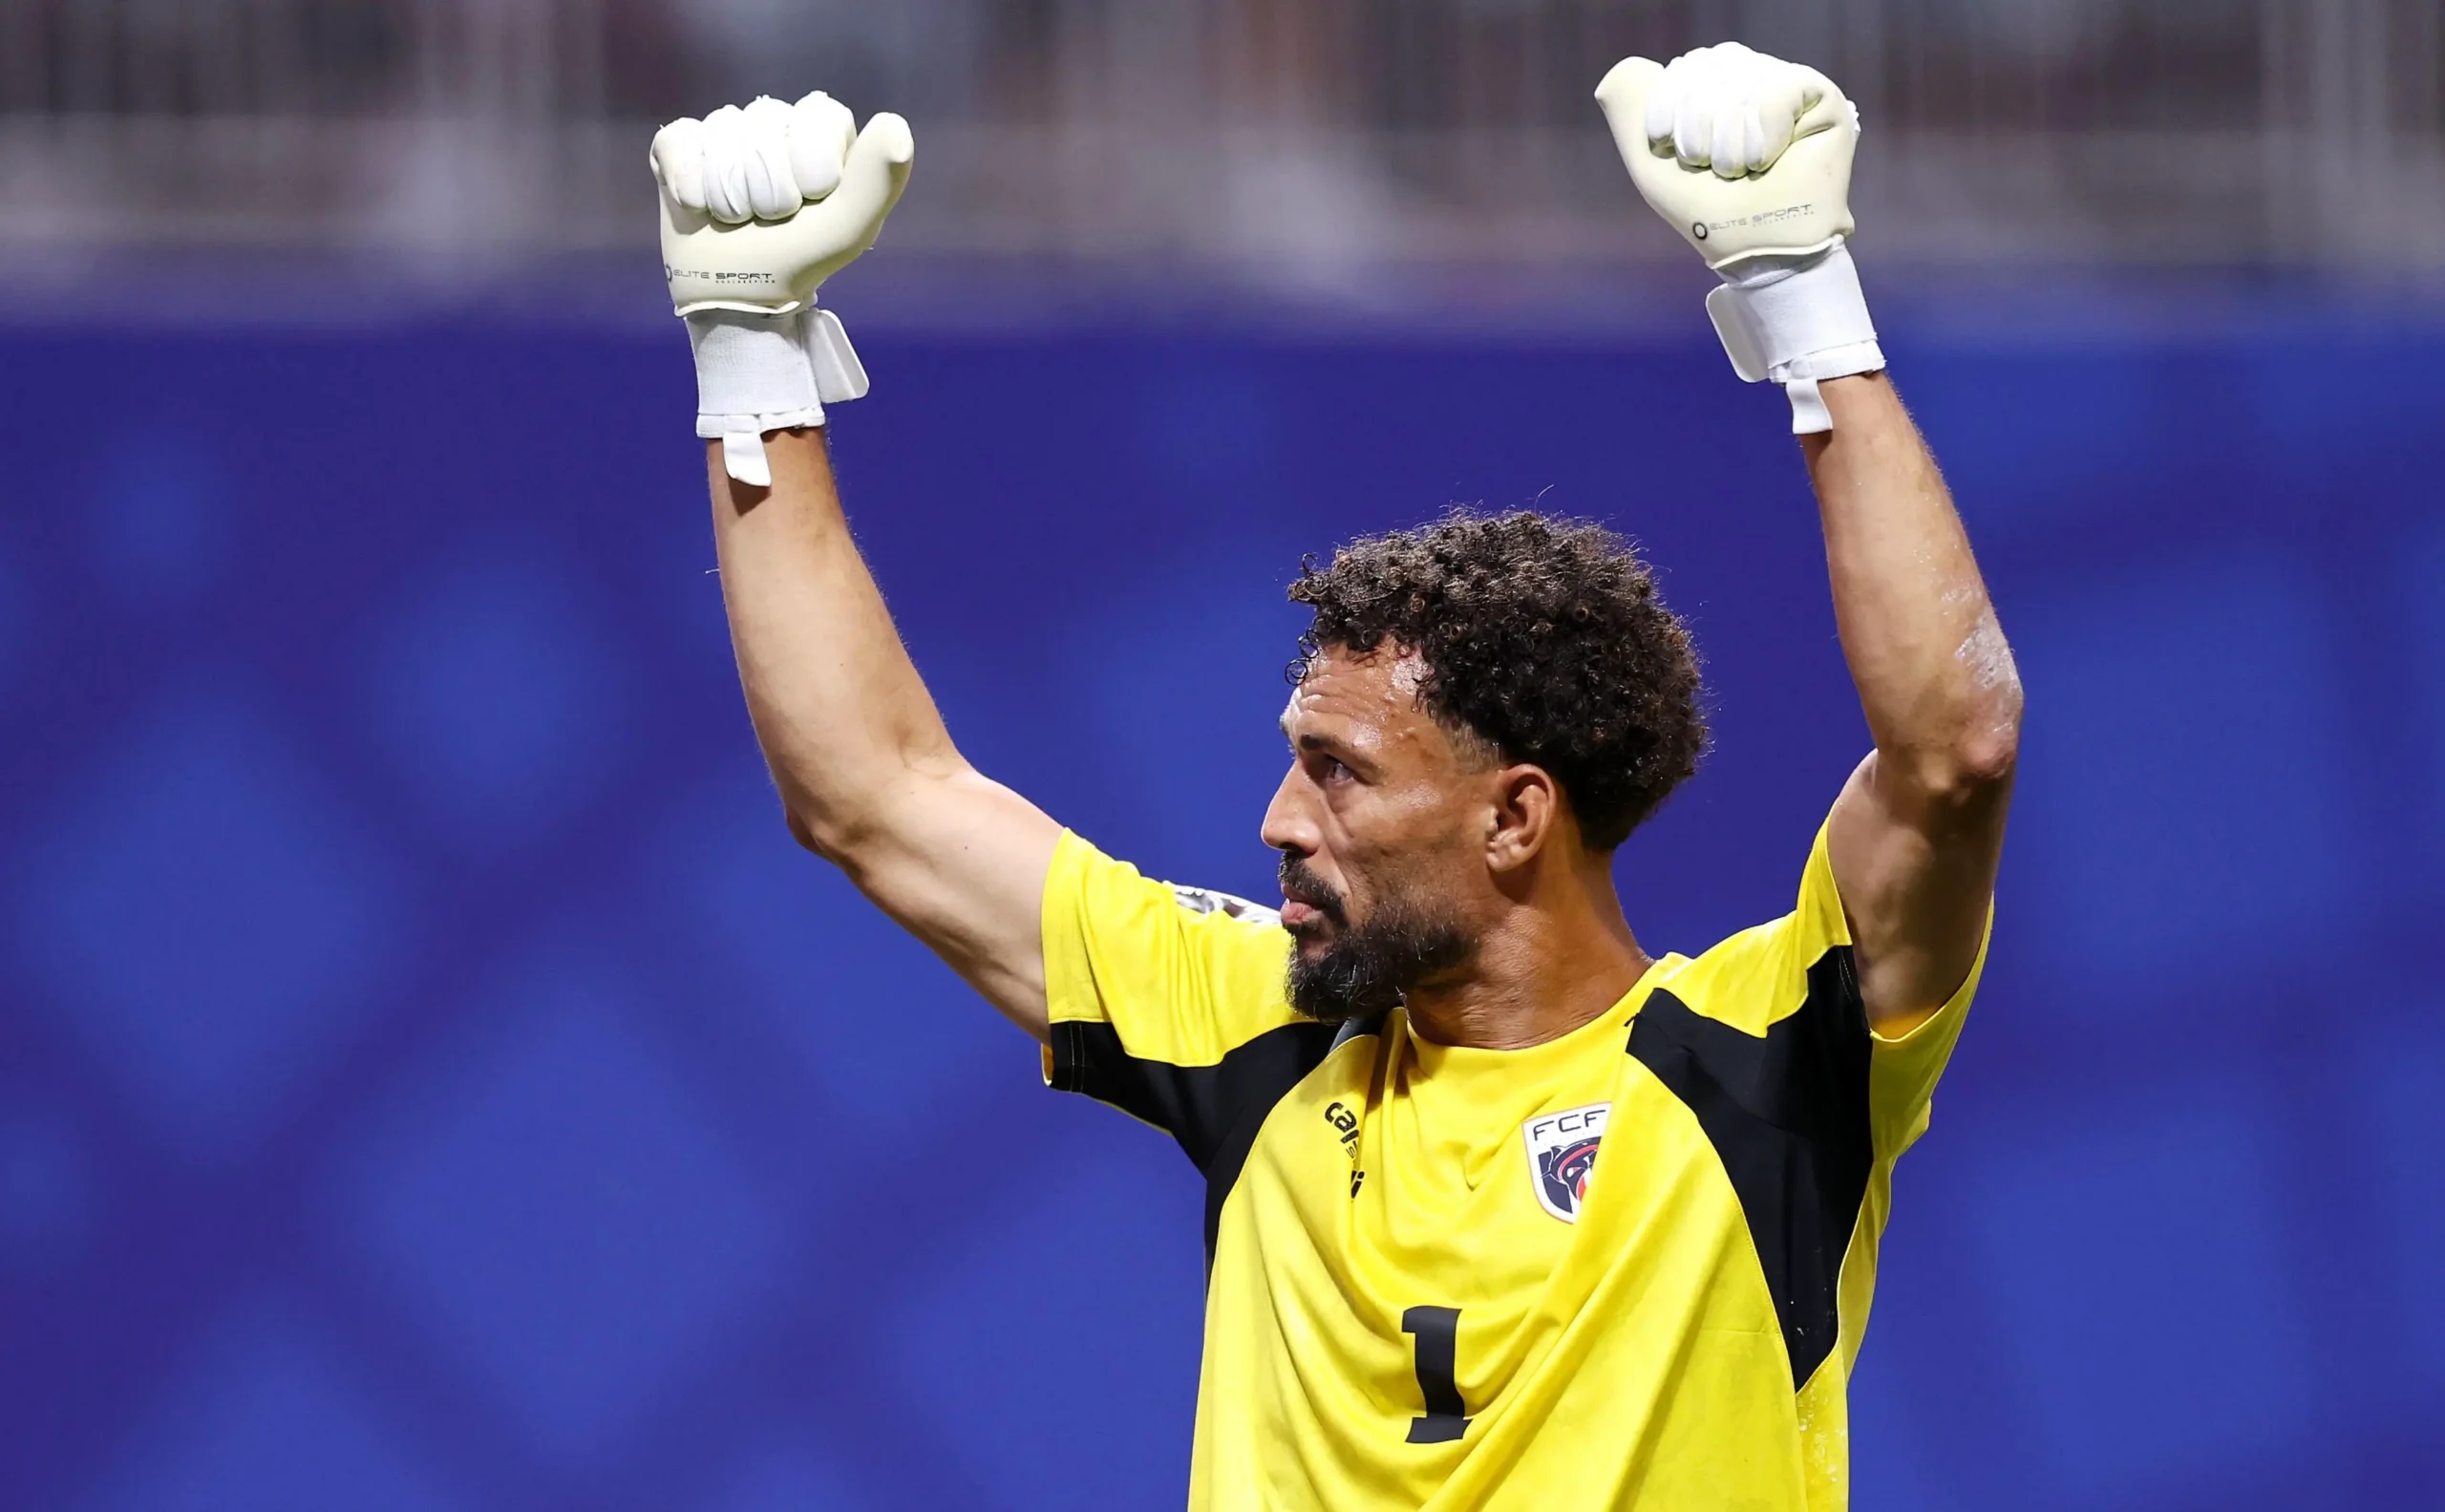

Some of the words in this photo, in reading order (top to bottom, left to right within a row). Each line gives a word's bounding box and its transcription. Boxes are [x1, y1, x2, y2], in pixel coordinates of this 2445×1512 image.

[1710, 218, 1747, 230] ELITE
[1752, 203, 1812, 223] SPORT
[673, 269, 710, 279] ELITE
[1533, 1109, 1606, 1141] FCF
[1401, 1305, 1474, 1444] 1
